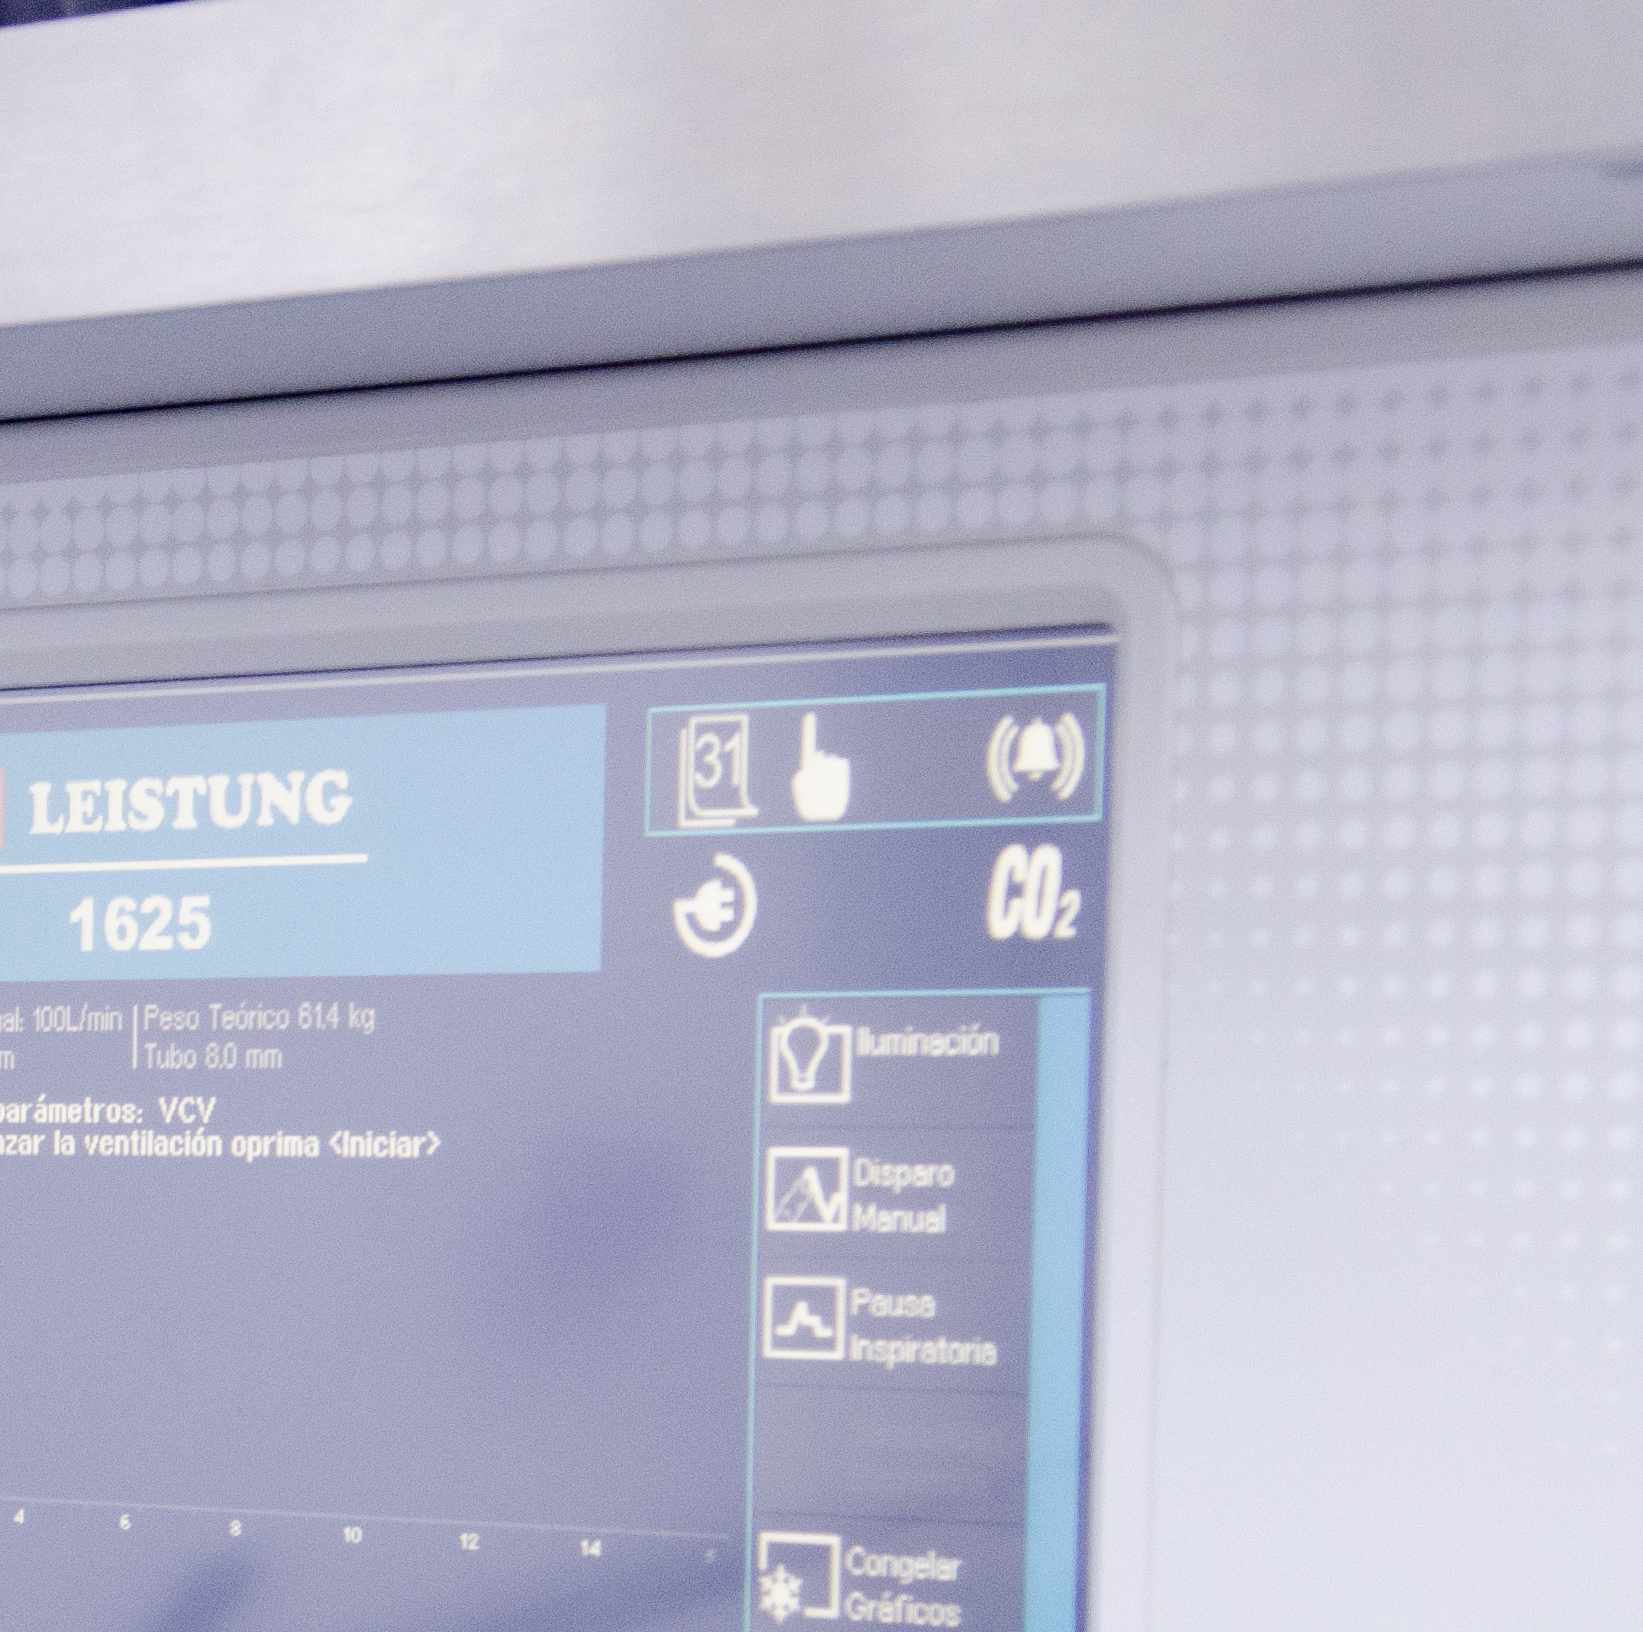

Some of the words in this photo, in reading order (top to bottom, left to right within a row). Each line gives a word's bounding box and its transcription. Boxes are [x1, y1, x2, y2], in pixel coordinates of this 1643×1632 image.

[693, 731, 742, 790] 31
[28, 769, 353, 836] LEISTUNG
[68, 894, 212, 953] 1625
[33, 1002, 124, 1032] 100L/min
[143, 1003, 200, 1032] Peso
[208, 1001, 290, 1032] Teórico
[298, 1001, 340, 1031] 61.4
[348, 1001, 376, 1035] kg
[143, 1042, 197, 1070] Tubo
[244, 1047, 283, 1070] mm
[856, 1022, 1000, 1058] Iluminación
[158, 1096, 217, 1124] VCV
[53, 1129, 75, 1156] la
[83, 1127, 222, 1157] ventilación
[230, 1129, 320, 1163] oprima
[328, 1129, 441, 1159] <Iniciar>
[852, 1156, 956, 1195] Disparo
[851, 1202, 947, 1234] Manual
[849, 1286, 937, 1319] Pausa
[848, 1334, 998, 1370] Inspiratoria
[14, 1508, 25, 1525] 4
[343, 1526, 363, 1544] 10
[460, 1532, 481, 1551] 12
[580, 1539, 602, 1558] 14
[844, 1545, 962, 1585] Congelar
[843, 1590, 962, 1628] Gráficos
